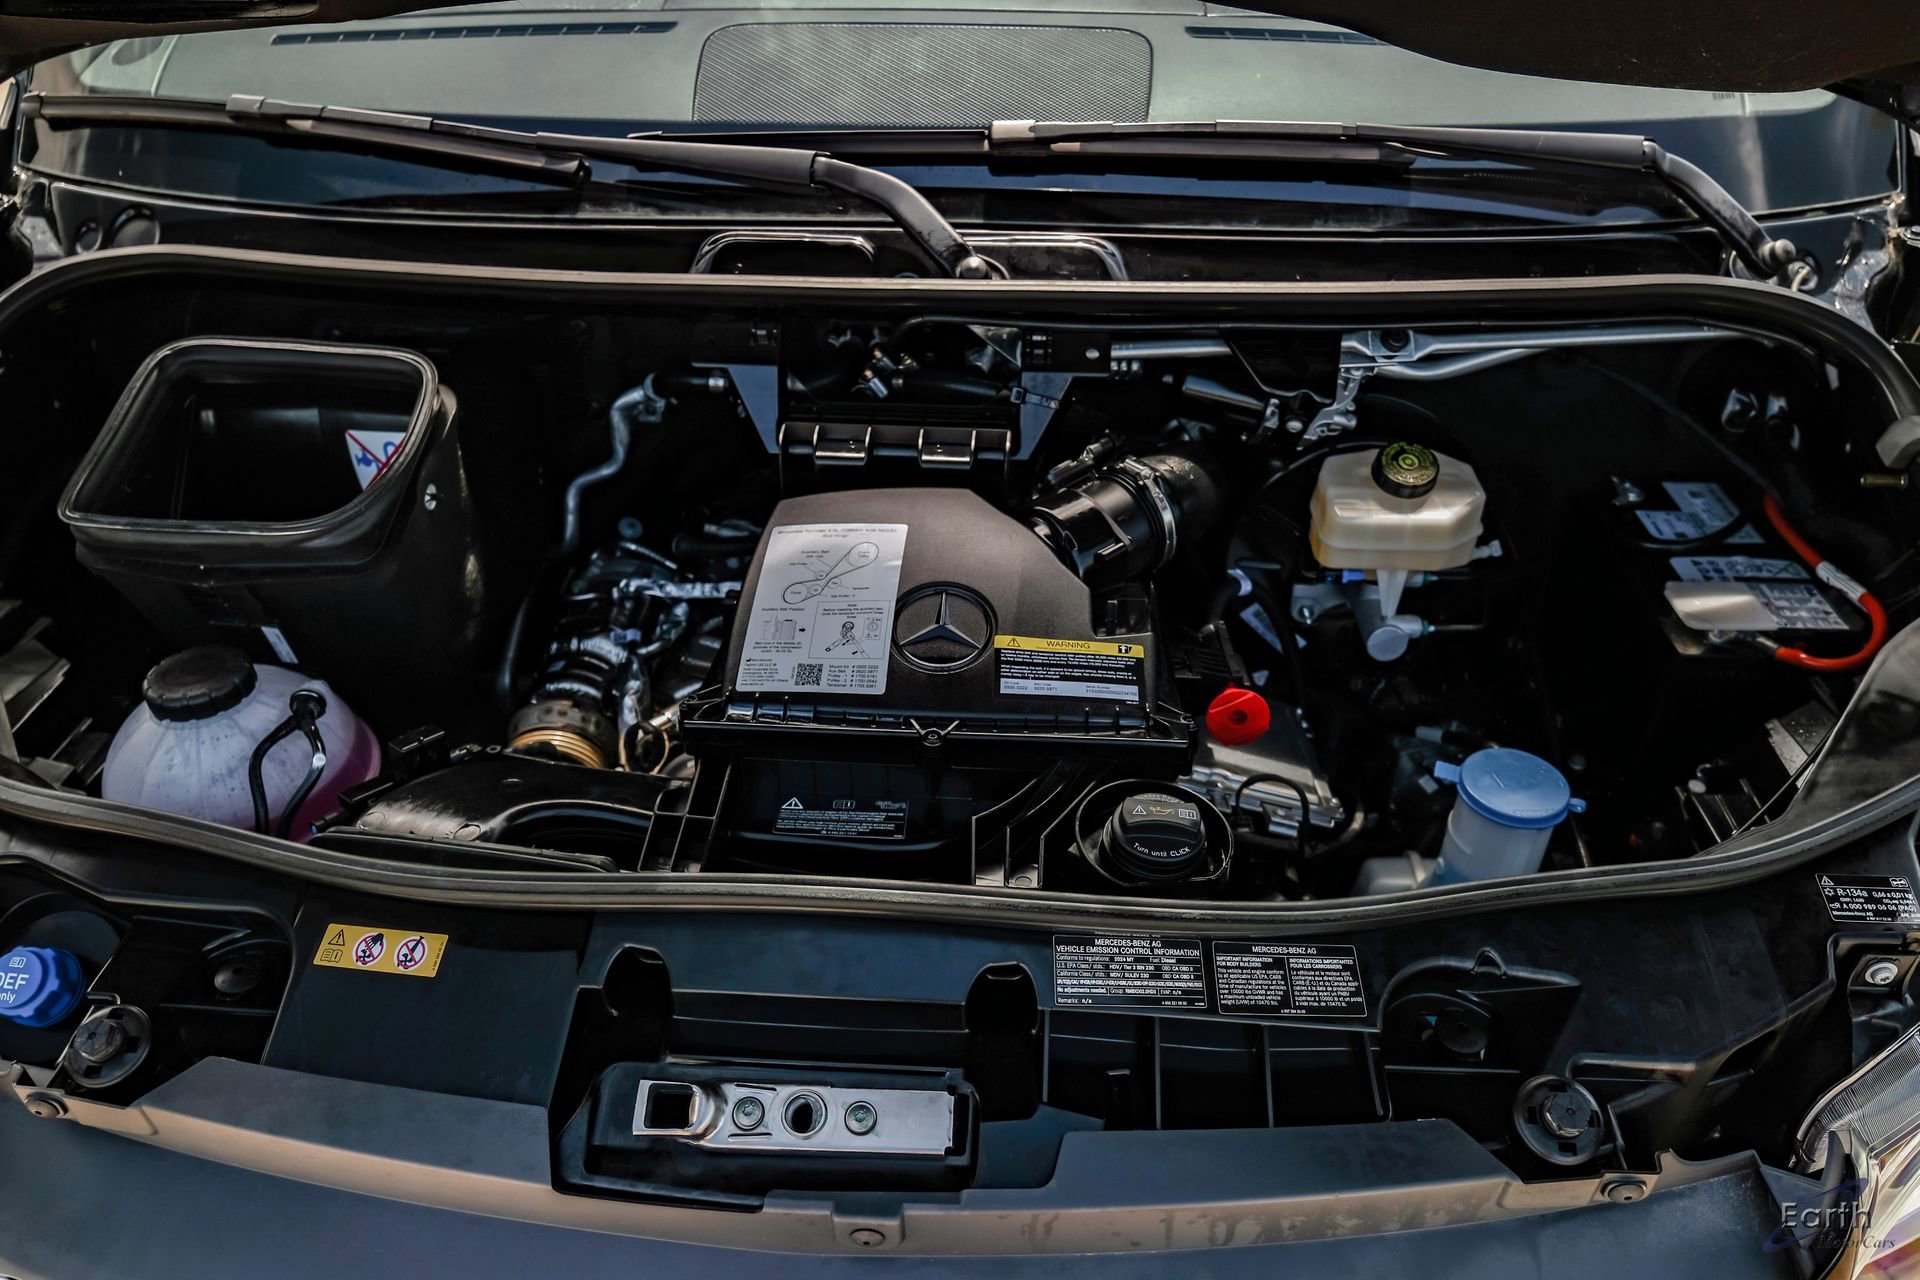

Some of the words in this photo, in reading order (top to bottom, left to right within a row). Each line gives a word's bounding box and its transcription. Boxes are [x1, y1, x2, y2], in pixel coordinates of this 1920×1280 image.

[1046, 640, 1090, 649] WARNING
[1134, 842, 1149, 854] Turn
[1170, 846, 1191, 857] CLICK
[1836, 888, 1868, 897] R-134a
[1094, 938, 1150, 947] MERCEDES-BENZ
[1154, 948, 1200, 956] INFORMATION
[1252, 946, 1306, 954] MERCEDES-BENZ
[0, 991, 16, 1004] nly
